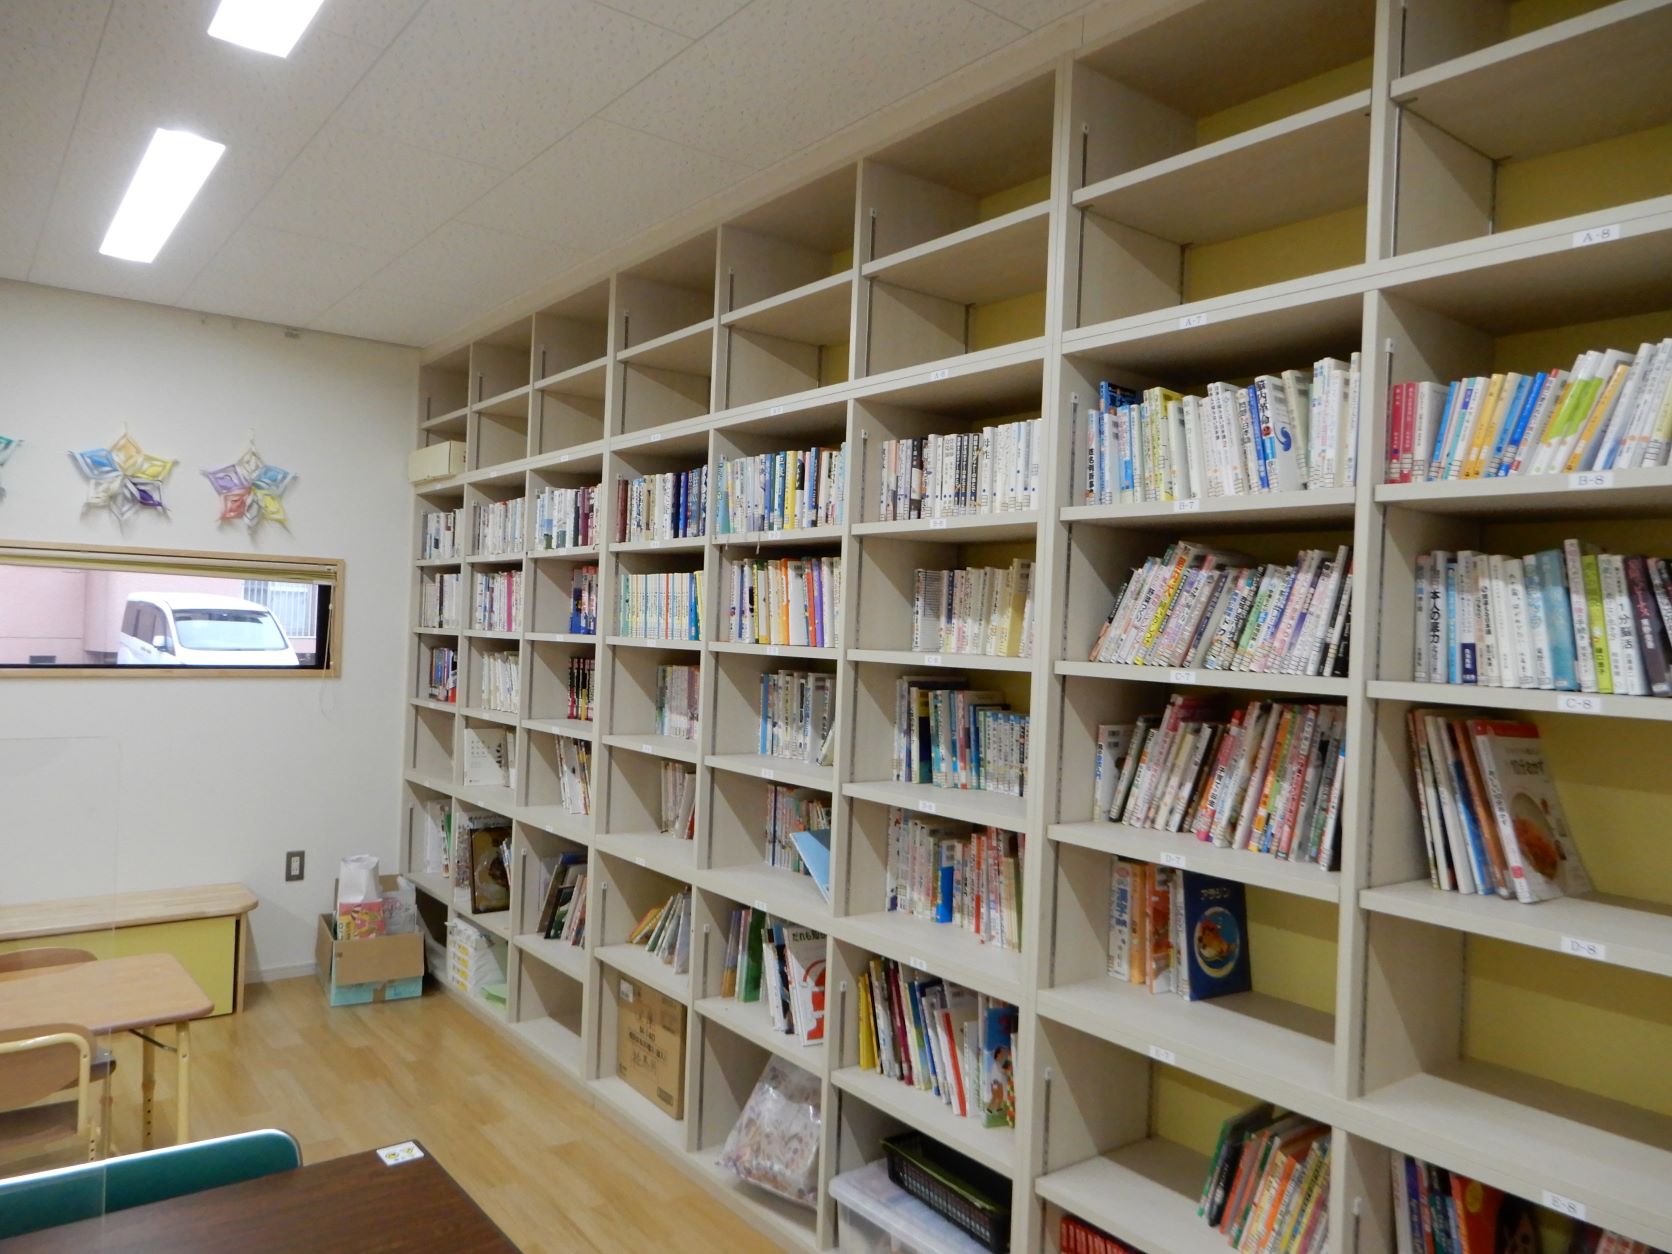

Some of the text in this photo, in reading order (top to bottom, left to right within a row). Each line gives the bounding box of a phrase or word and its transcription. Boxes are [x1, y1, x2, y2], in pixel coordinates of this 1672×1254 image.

[1582, 228, 1610, 243] A-8
[1184, 315, 1202, 327] A-7
[1578, 476, 1604, 486] B-8
[1565, 698, 1593, 709] C-8
[1569, 940, 1597, 955] D-8
[1551, 1195, 1578, 1214] E-8
